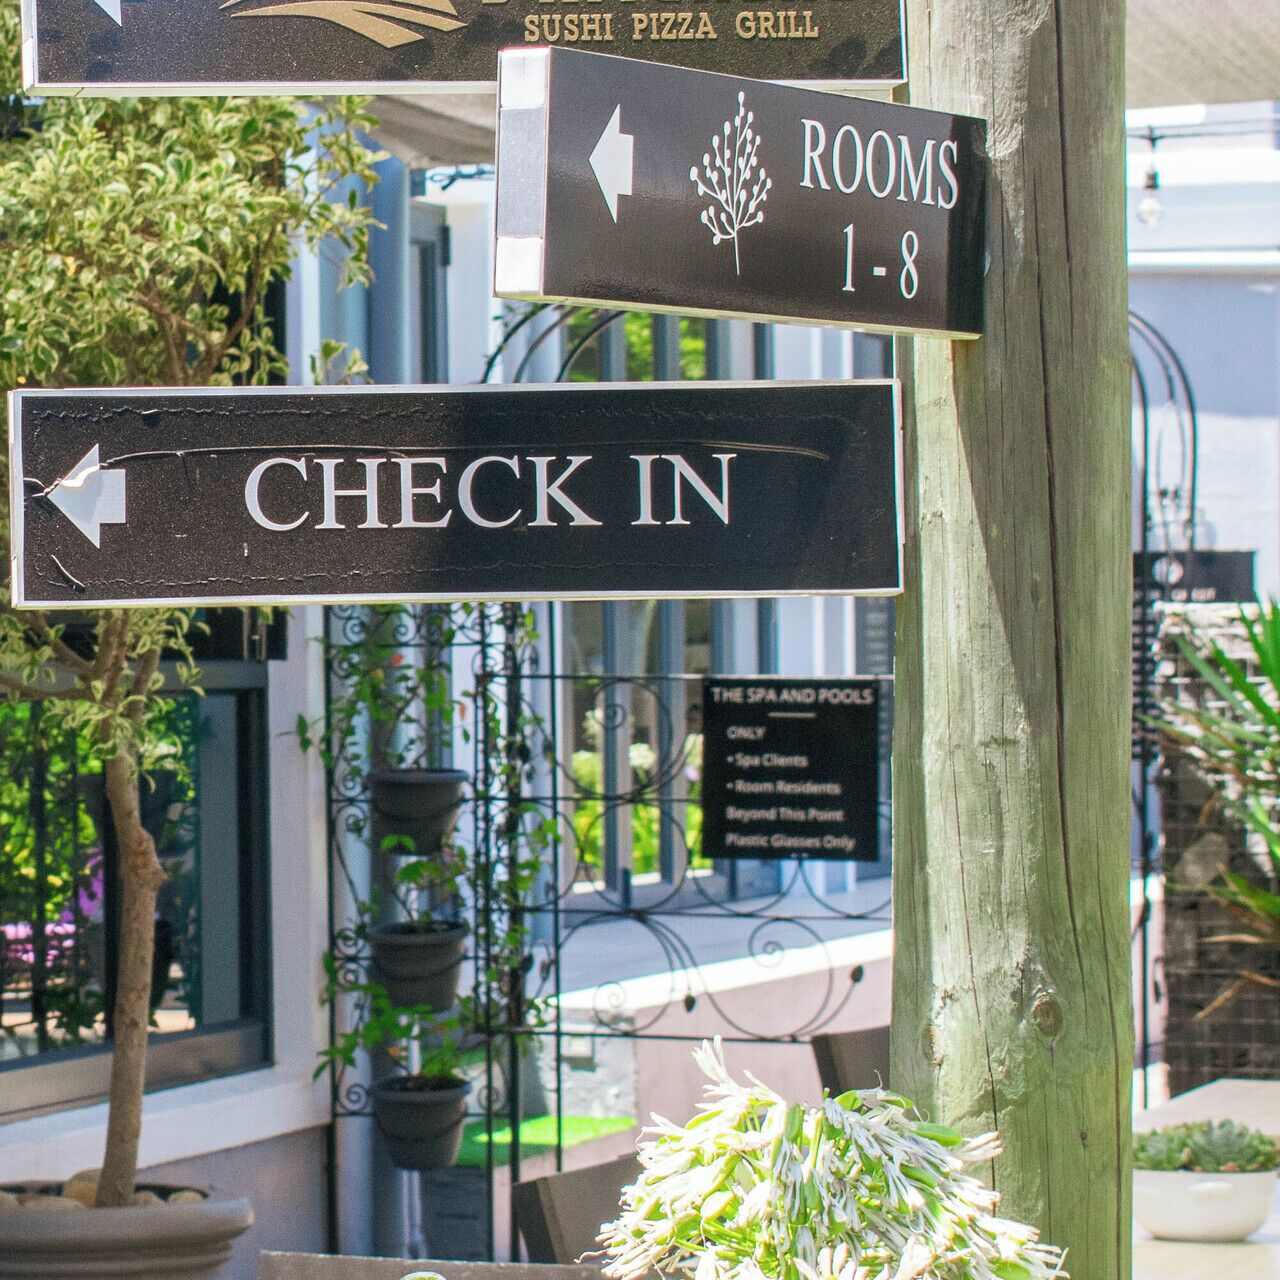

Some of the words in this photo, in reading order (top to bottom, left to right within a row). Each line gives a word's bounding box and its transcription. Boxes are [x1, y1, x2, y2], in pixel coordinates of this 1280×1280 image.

[523, 10, 616, 43] SUSHI
[630, 8, 718, 41] PIZZA
[734, 7, 820, 39] GRILL
[800, 118, 960, 210] ROOMS
[244, 454, 603, 532] CHECK
[629, 453, 737, 526] IN
[711, 687, 745, 703] THE
[747, 687, 778, 703] SPA
[780, 687, 816, 704] AND
[818, 688, 874, 705] POOLS
[726, 725, 766, 741] ONLY
[734, 753, 761, 769] Spa
[762, 753, 810, 769] Clients
[734, 779, 774, 794] Room
[775, 779, 843, 796] Residents
[726, 806, 778, 823] Beyond
